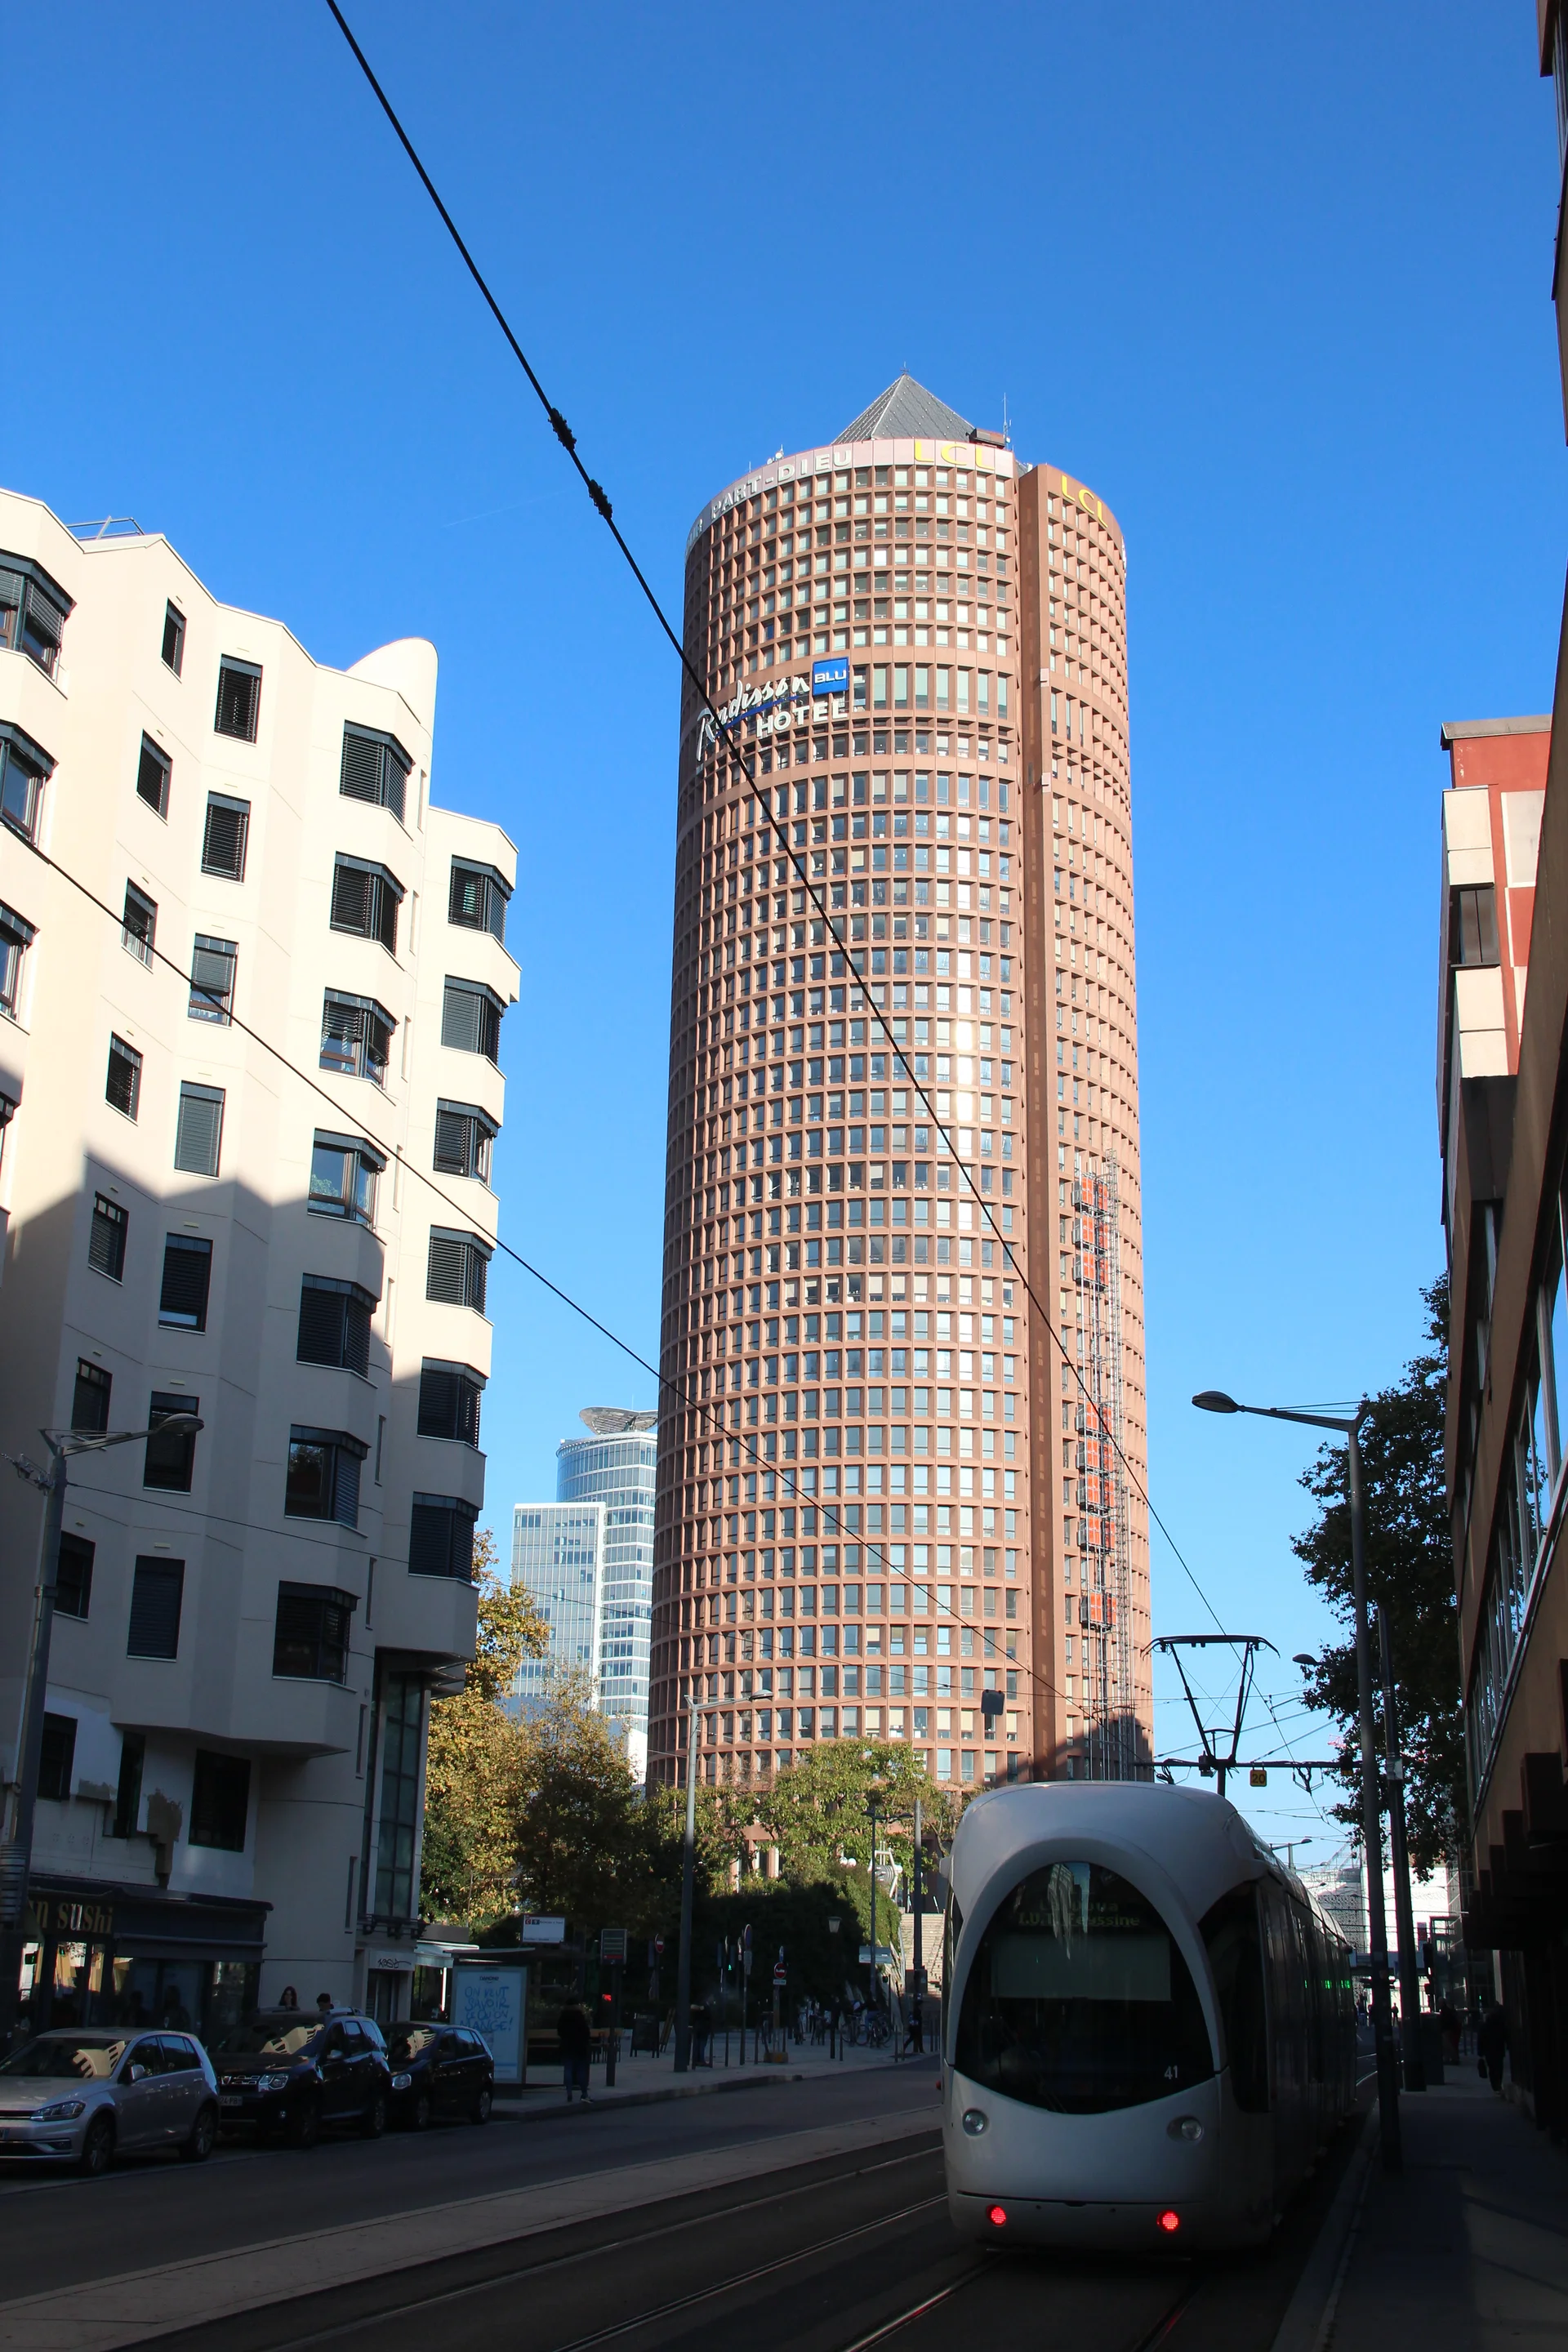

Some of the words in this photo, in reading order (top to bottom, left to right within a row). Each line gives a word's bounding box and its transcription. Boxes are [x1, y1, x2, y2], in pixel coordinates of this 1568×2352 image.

[914, 439, 995, 470] LCL
[710, 449, 852, 521] PART-DIEU
[1061, 474, 1108, 528] LCL
[697, 676, 810, 762] Radisson
[813, 669, 847, 684] BLU
[756, 700, 849, 739] HOTEL
[1252, 1773, 1266, 1784] 20
[56, 1901, 114, 1935] sushi
[465, 1986, 480, 1998] ON
[484, 1986, 510, 1998] VEUT
[465, 1998, 510, 2012] SAVOIR
[1164, 2065, 1178, 2080] 41
